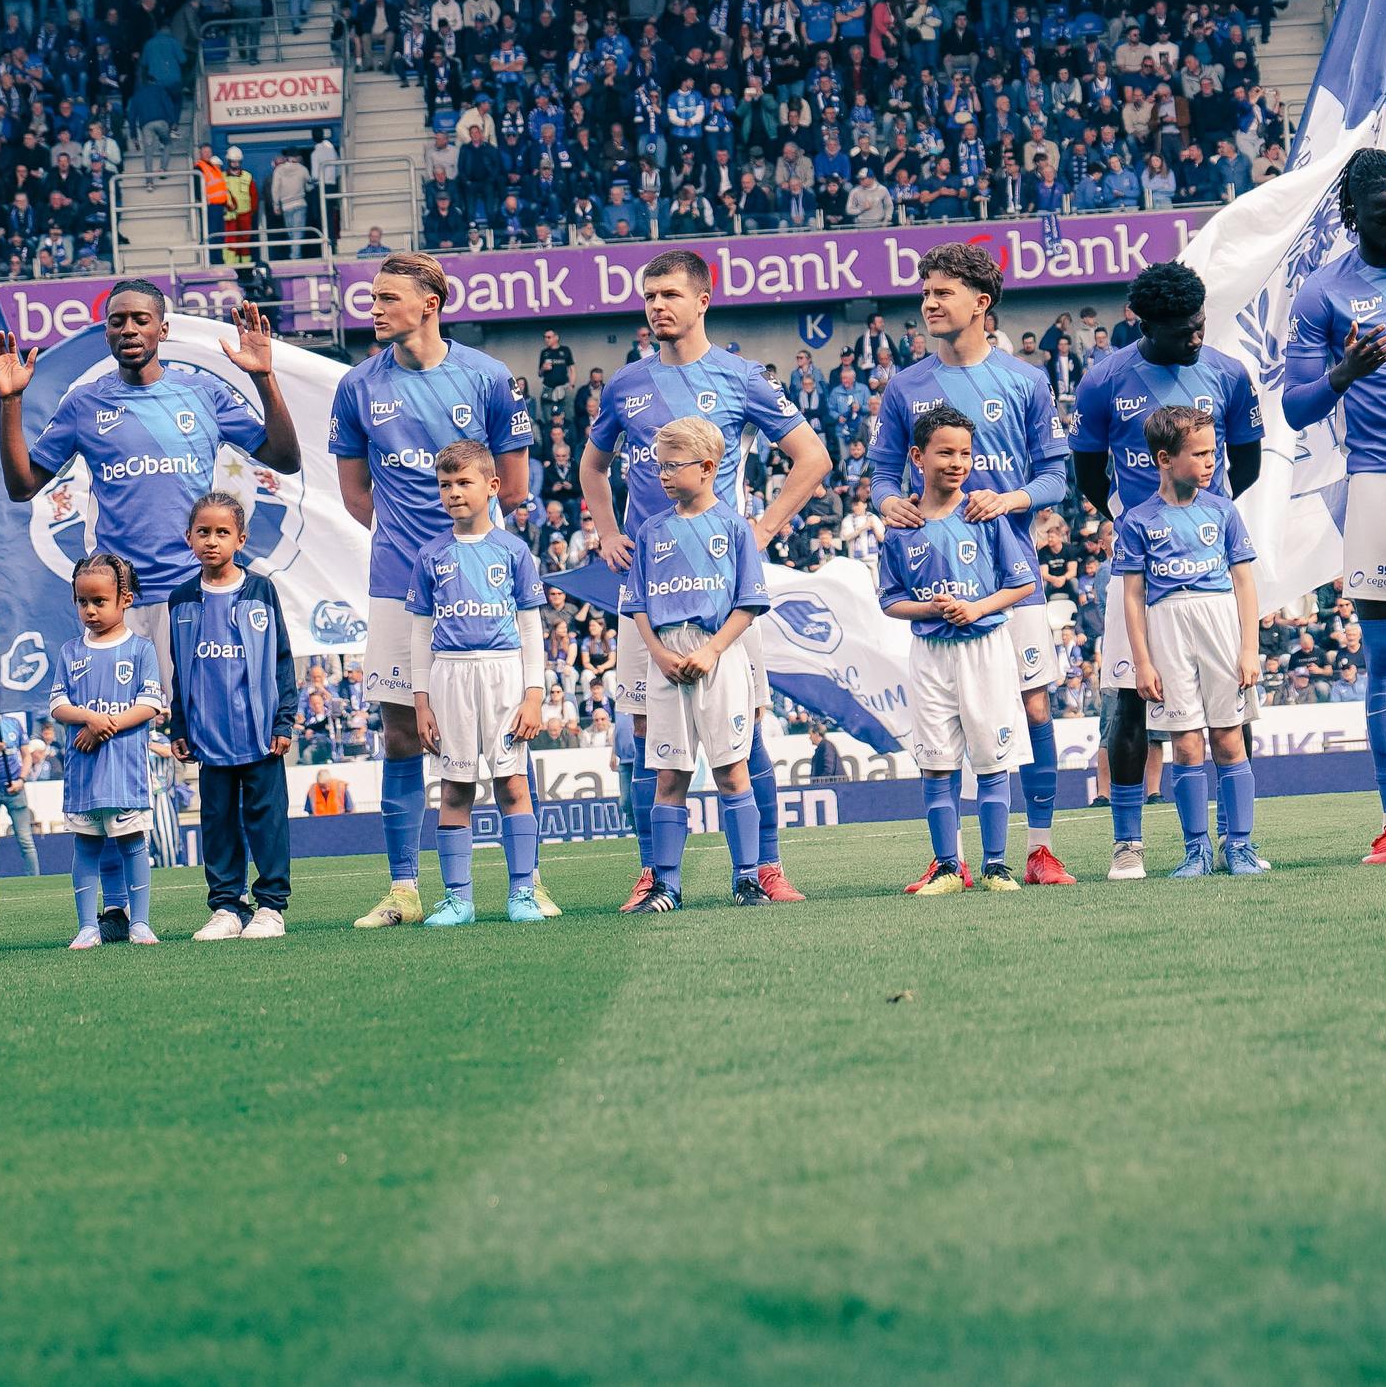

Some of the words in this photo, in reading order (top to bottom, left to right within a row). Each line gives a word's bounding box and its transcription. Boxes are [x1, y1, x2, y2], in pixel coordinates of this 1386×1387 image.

[213, 75, 340, 102] MECONA
[227, 101, 331, 117] VERANDABOUW
[1352, 298, 1376, 313] itzu
[806, 314, 827, 339] K
[370, 401, 396, 415] itzu
[624, 396, 648, 410] itzu
[1116, 400, 1141, 412] itzu
[95, 410, 118, 425] itzu
[511, 410, 529, 425] STA
[390, 667, 399, 677] 6
[377, 676, 413, 691] cegeka
[625, 691, 647, 702] cege
